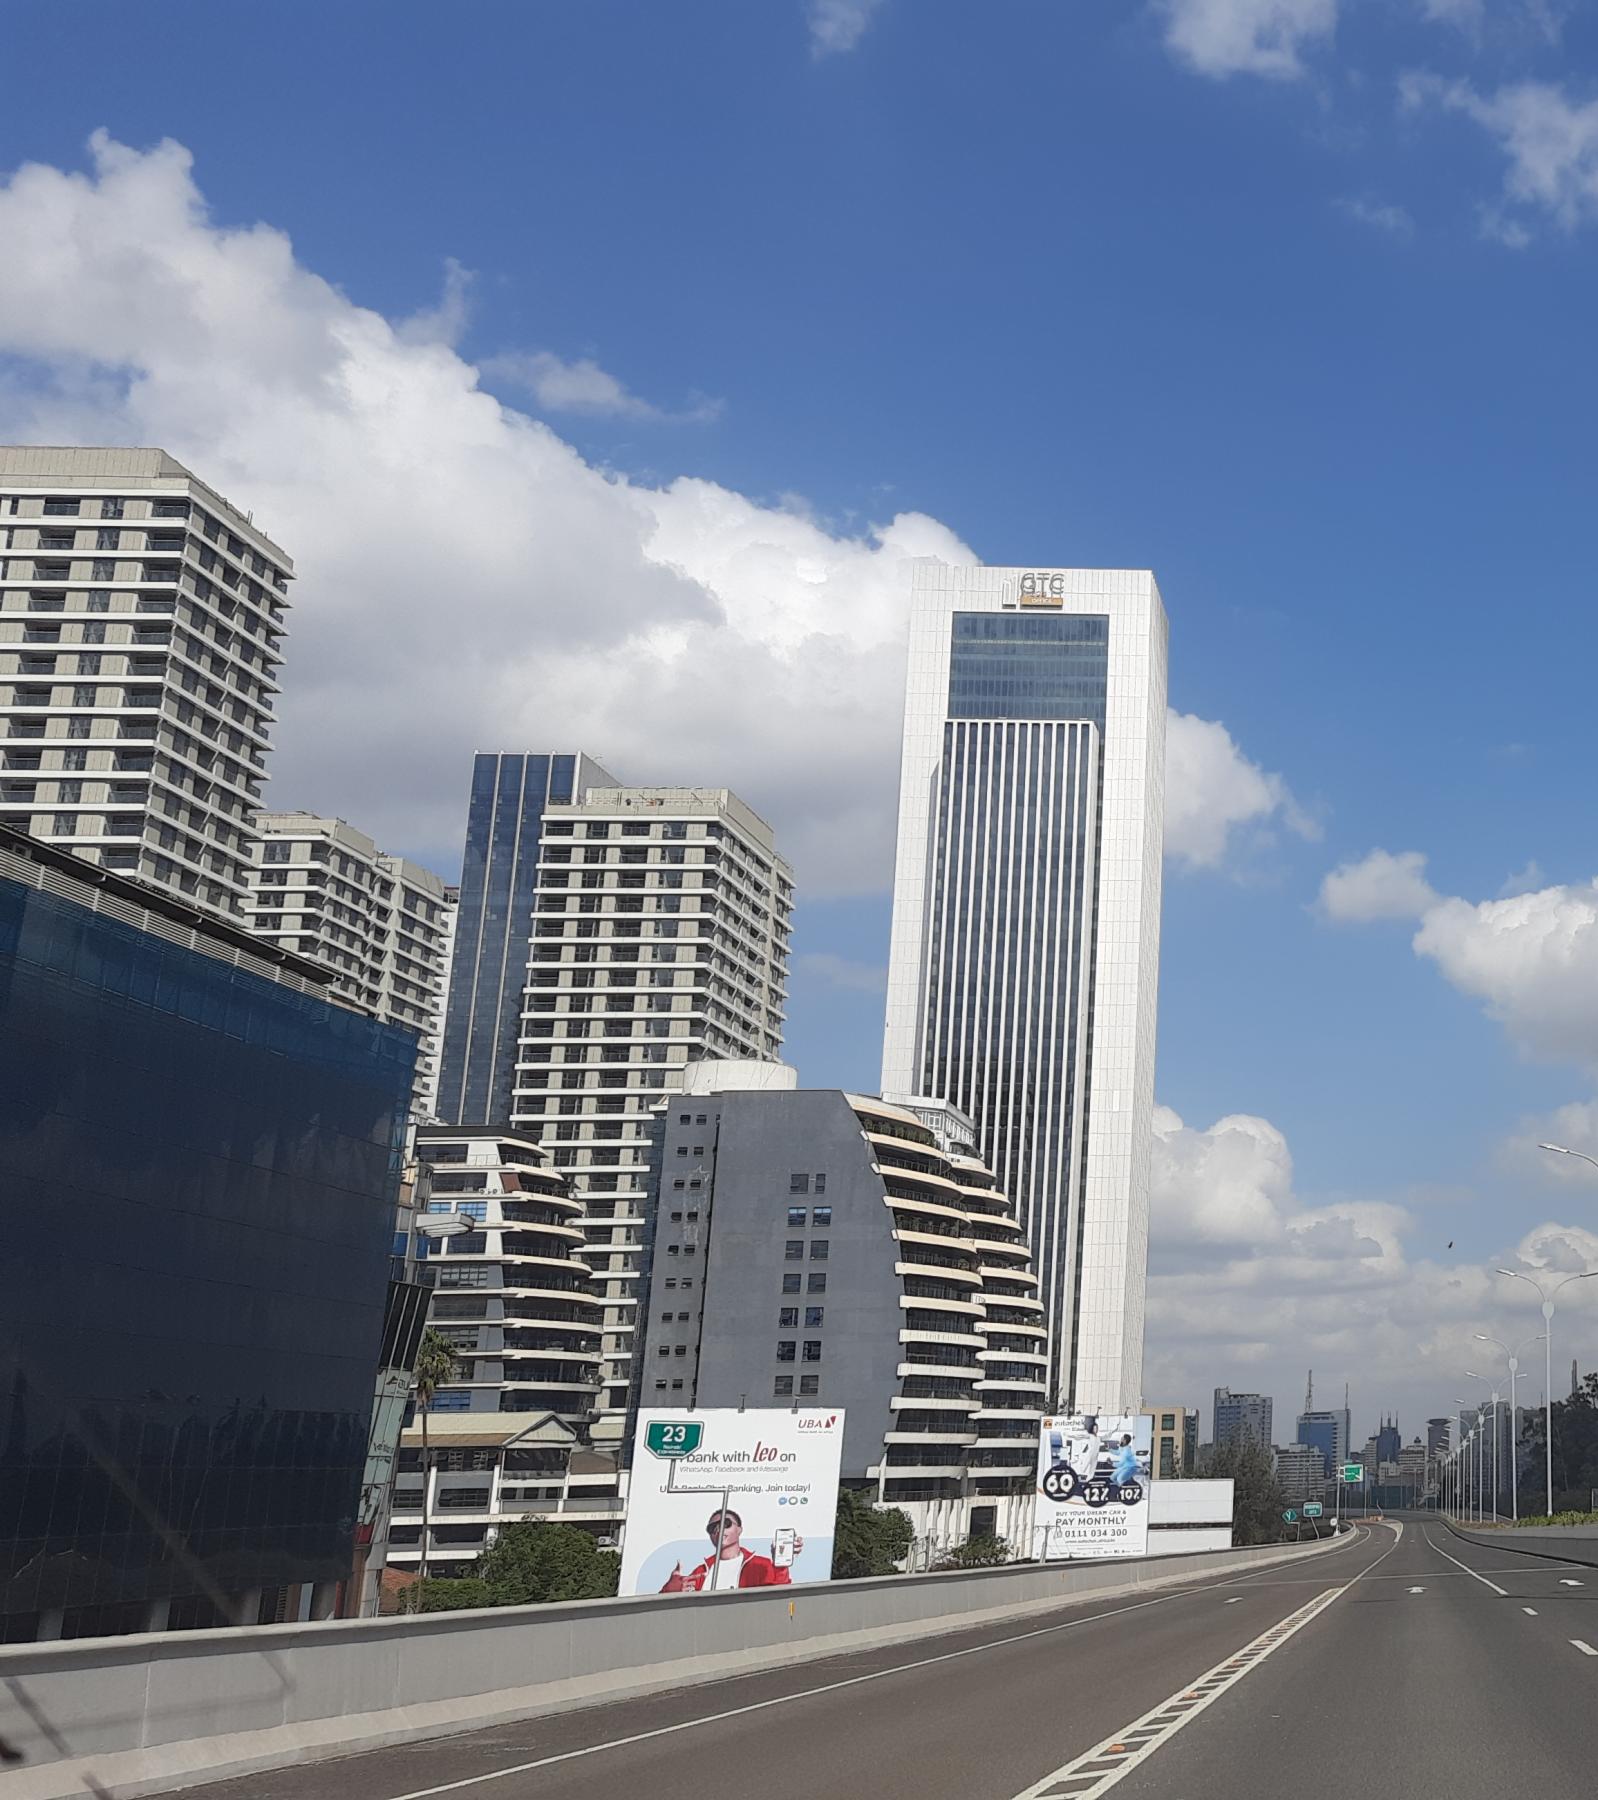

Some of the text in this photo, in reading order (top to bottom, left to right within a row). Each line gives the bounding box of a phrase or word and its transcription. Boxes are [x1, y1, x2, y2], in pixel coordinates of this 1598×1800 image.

[798, 1419, 822, 1429] UBA
[662, 1425, 686, 1442] 23
[687, 1450, 719, 1463] bank
[723, 1450, 750, 1463] with
[752, 1441, 778, 1463] Leo
[780, 1453, 796, 1463] on
[765, 1484, 783, 1492] Join
[784, 1483, 811, 1494] today!
[1046, 1474, 1074, 1494] 60
[1083, 1487, 1110, 1502] 12%
[1119, 1488, 1141, 1501] 10%
[1055, 1516, 1127, 1526] PAY MONTHLY
